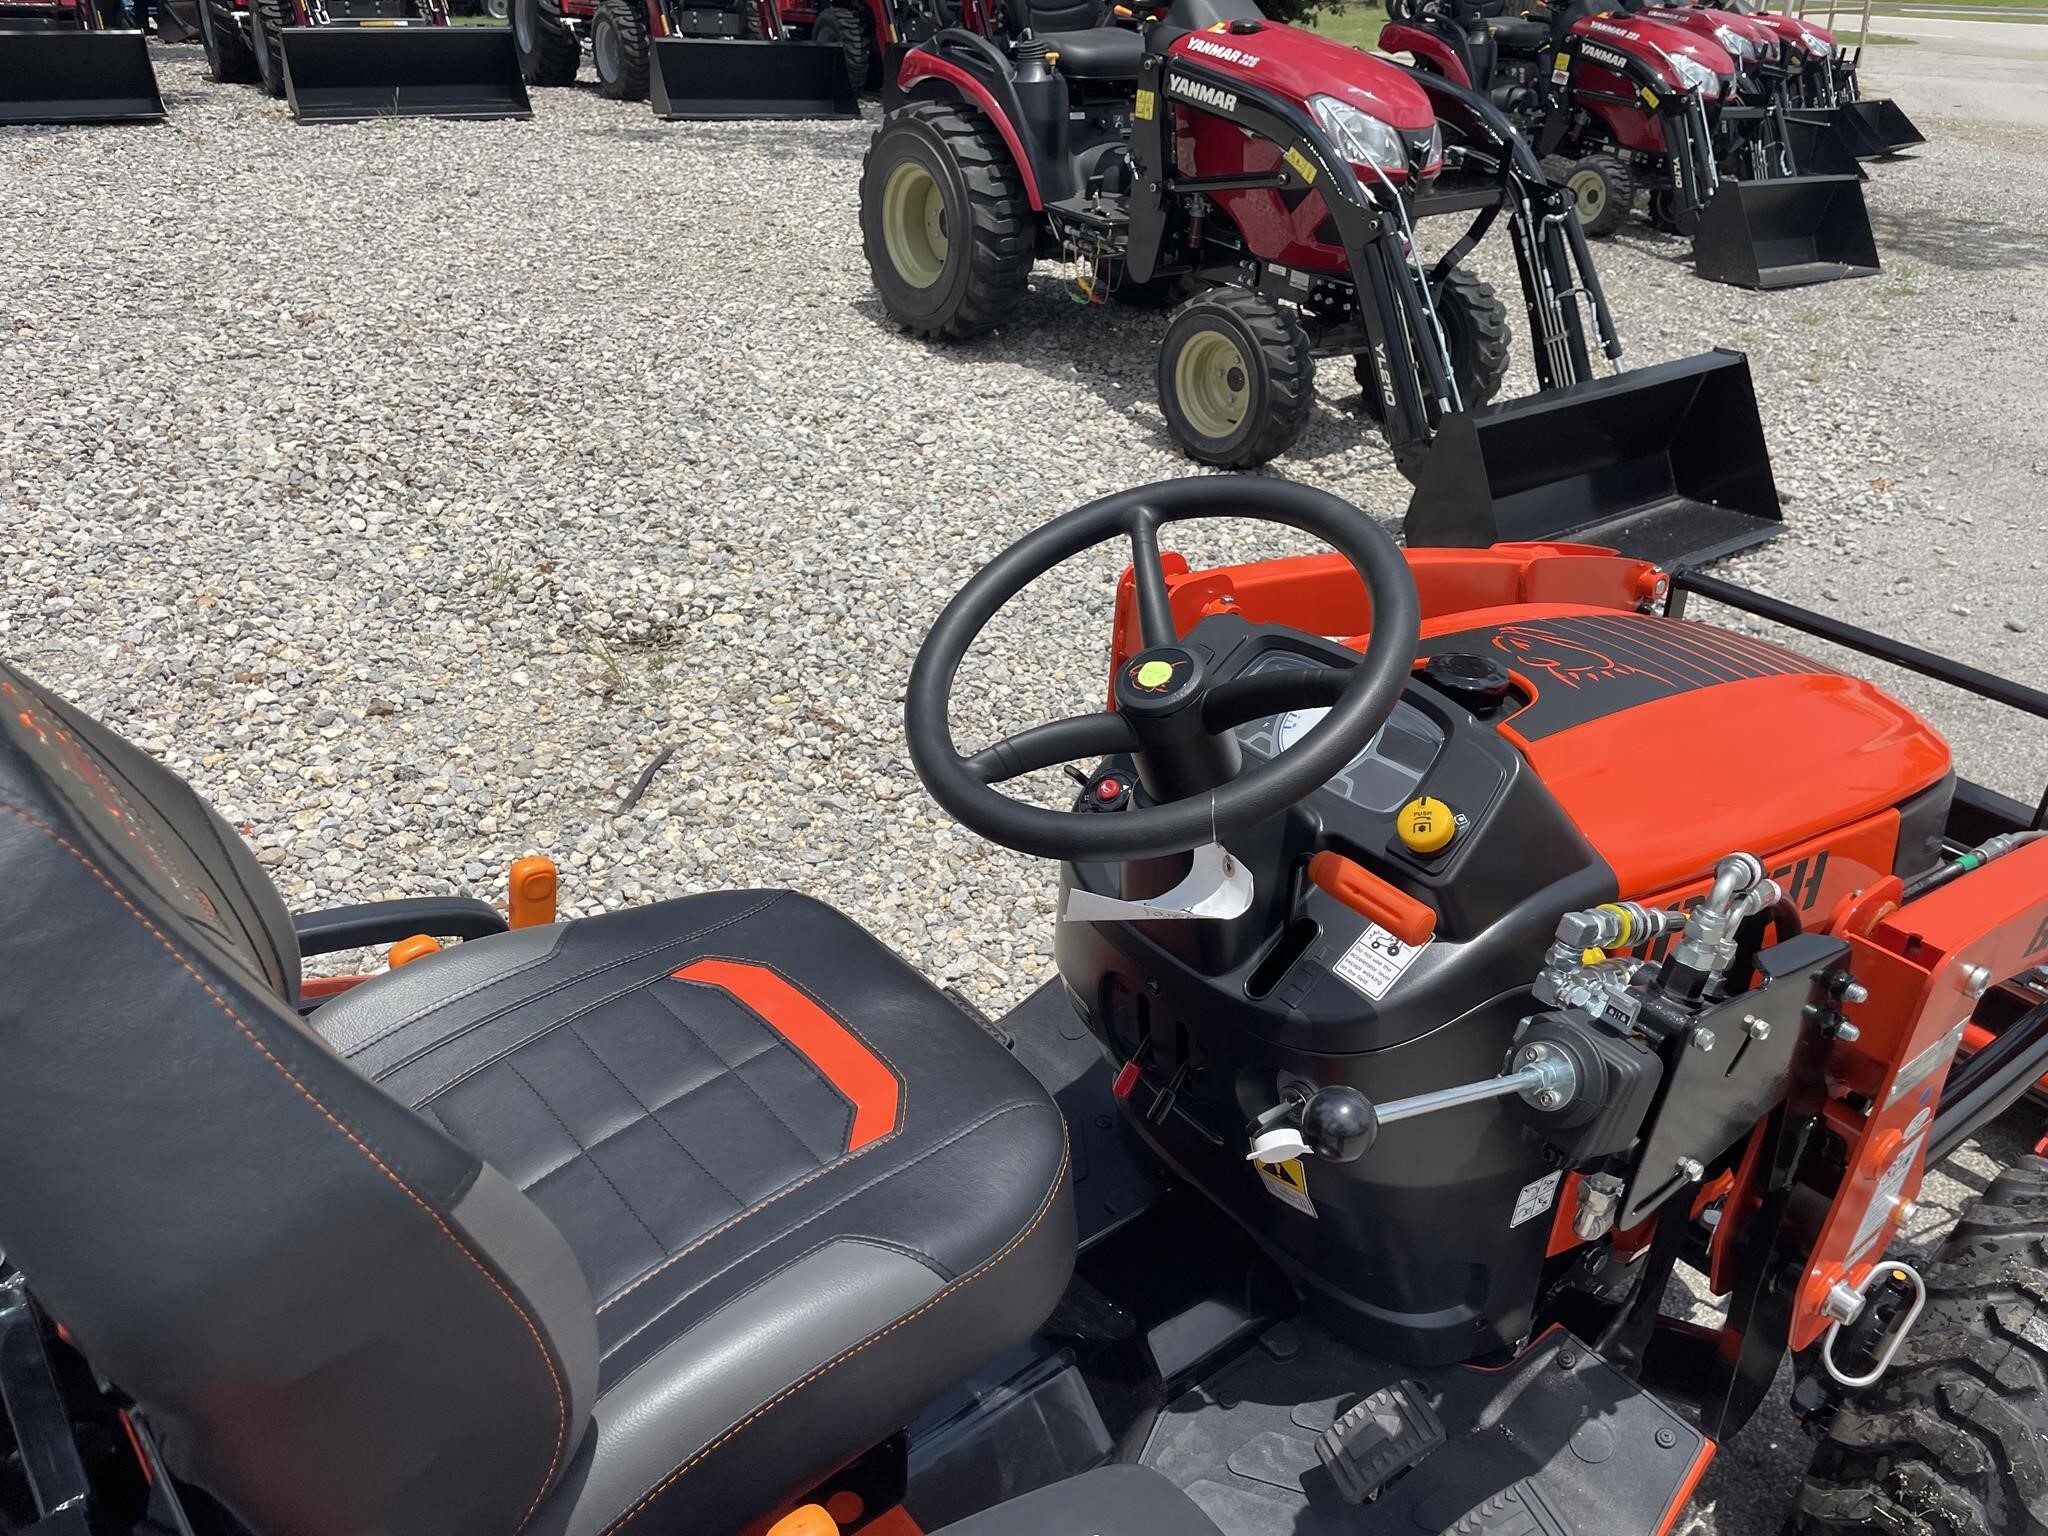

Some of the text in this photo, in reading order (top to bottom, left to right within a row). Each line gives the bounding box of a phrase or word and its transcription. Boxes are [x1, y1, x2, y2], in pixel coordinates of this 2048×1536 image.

[1590, 21, 1627, 37] YANMAR
[1186, 36, 1242, 63] YANMAR
[1580, 42, 1628, 69] YANMAR
[1169, 73, 1238, 112] YANMAR
[1374, 342, 1396, 407] YL210
[1339, 963, 1348, 971] on
[1347, 968, 1357, 977] the
[1345, 957, 1383, 986] except working
[1350, 951, 1391, 981] accelerator lever
[1355, 945, 1392, 972] Do not use the
